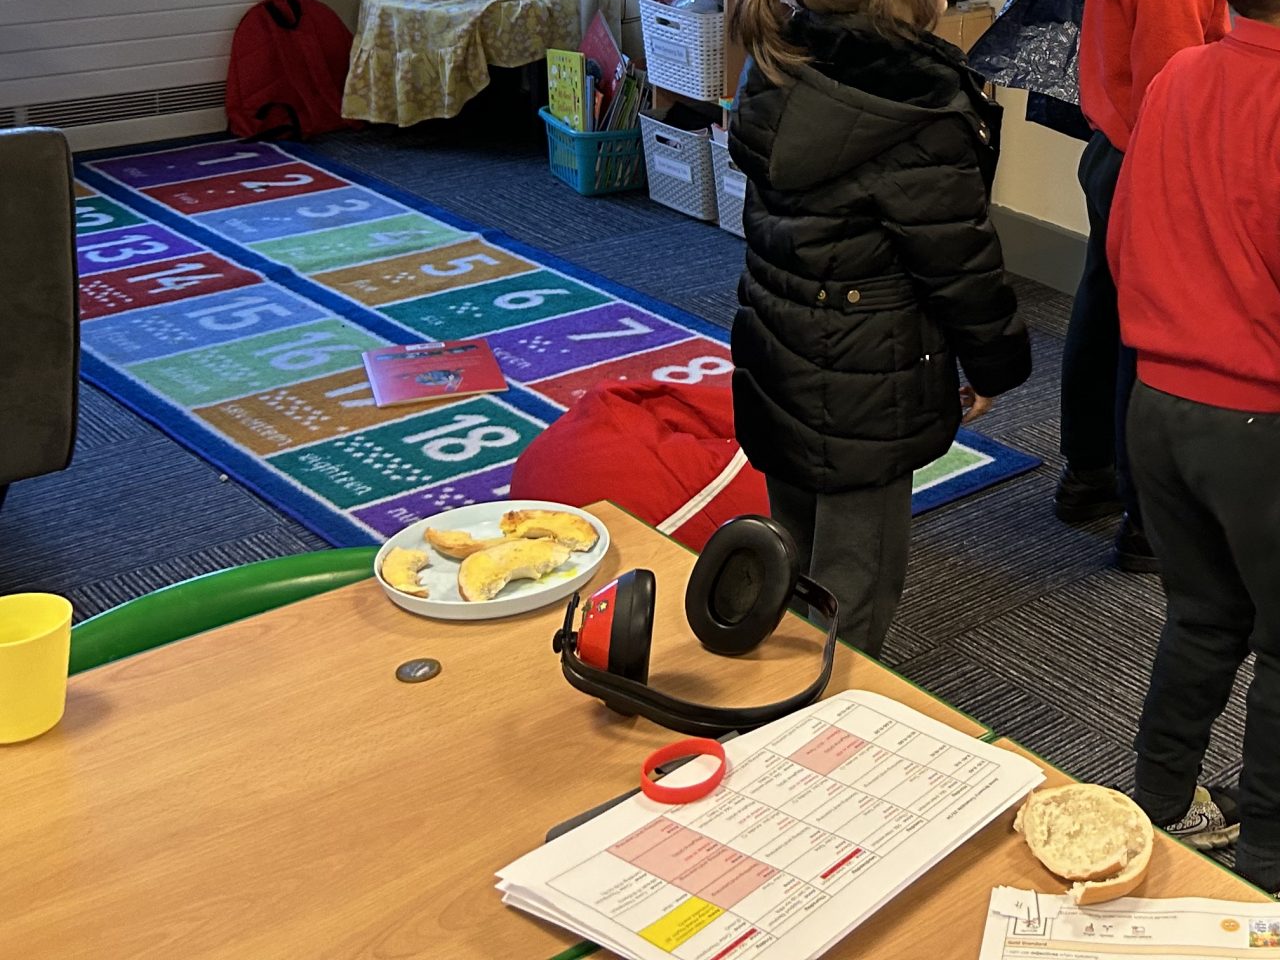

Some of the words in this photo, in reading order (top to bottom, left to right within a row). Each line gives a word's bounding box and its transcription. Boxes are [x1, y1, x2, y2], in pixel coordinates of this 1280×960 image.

[197, 152, 260, 166] 1
[240, 172, 315, 193] 2
[297, 198, 372, 219] 3
[77, 234, 169, 263] 13
[126, 263, 225, 295] 14
[420, 253, 501, 278] 5
[186, 296, 293, 331] 15
[493, 287, 571, 311] 6
[567, 316, 655, 342] 7
[254, 331, 360, 371] 16
[651, 356, 736, 385] 8
[401, 413, 522, 463] 18
[298, 451, 373, 496] eighteen
